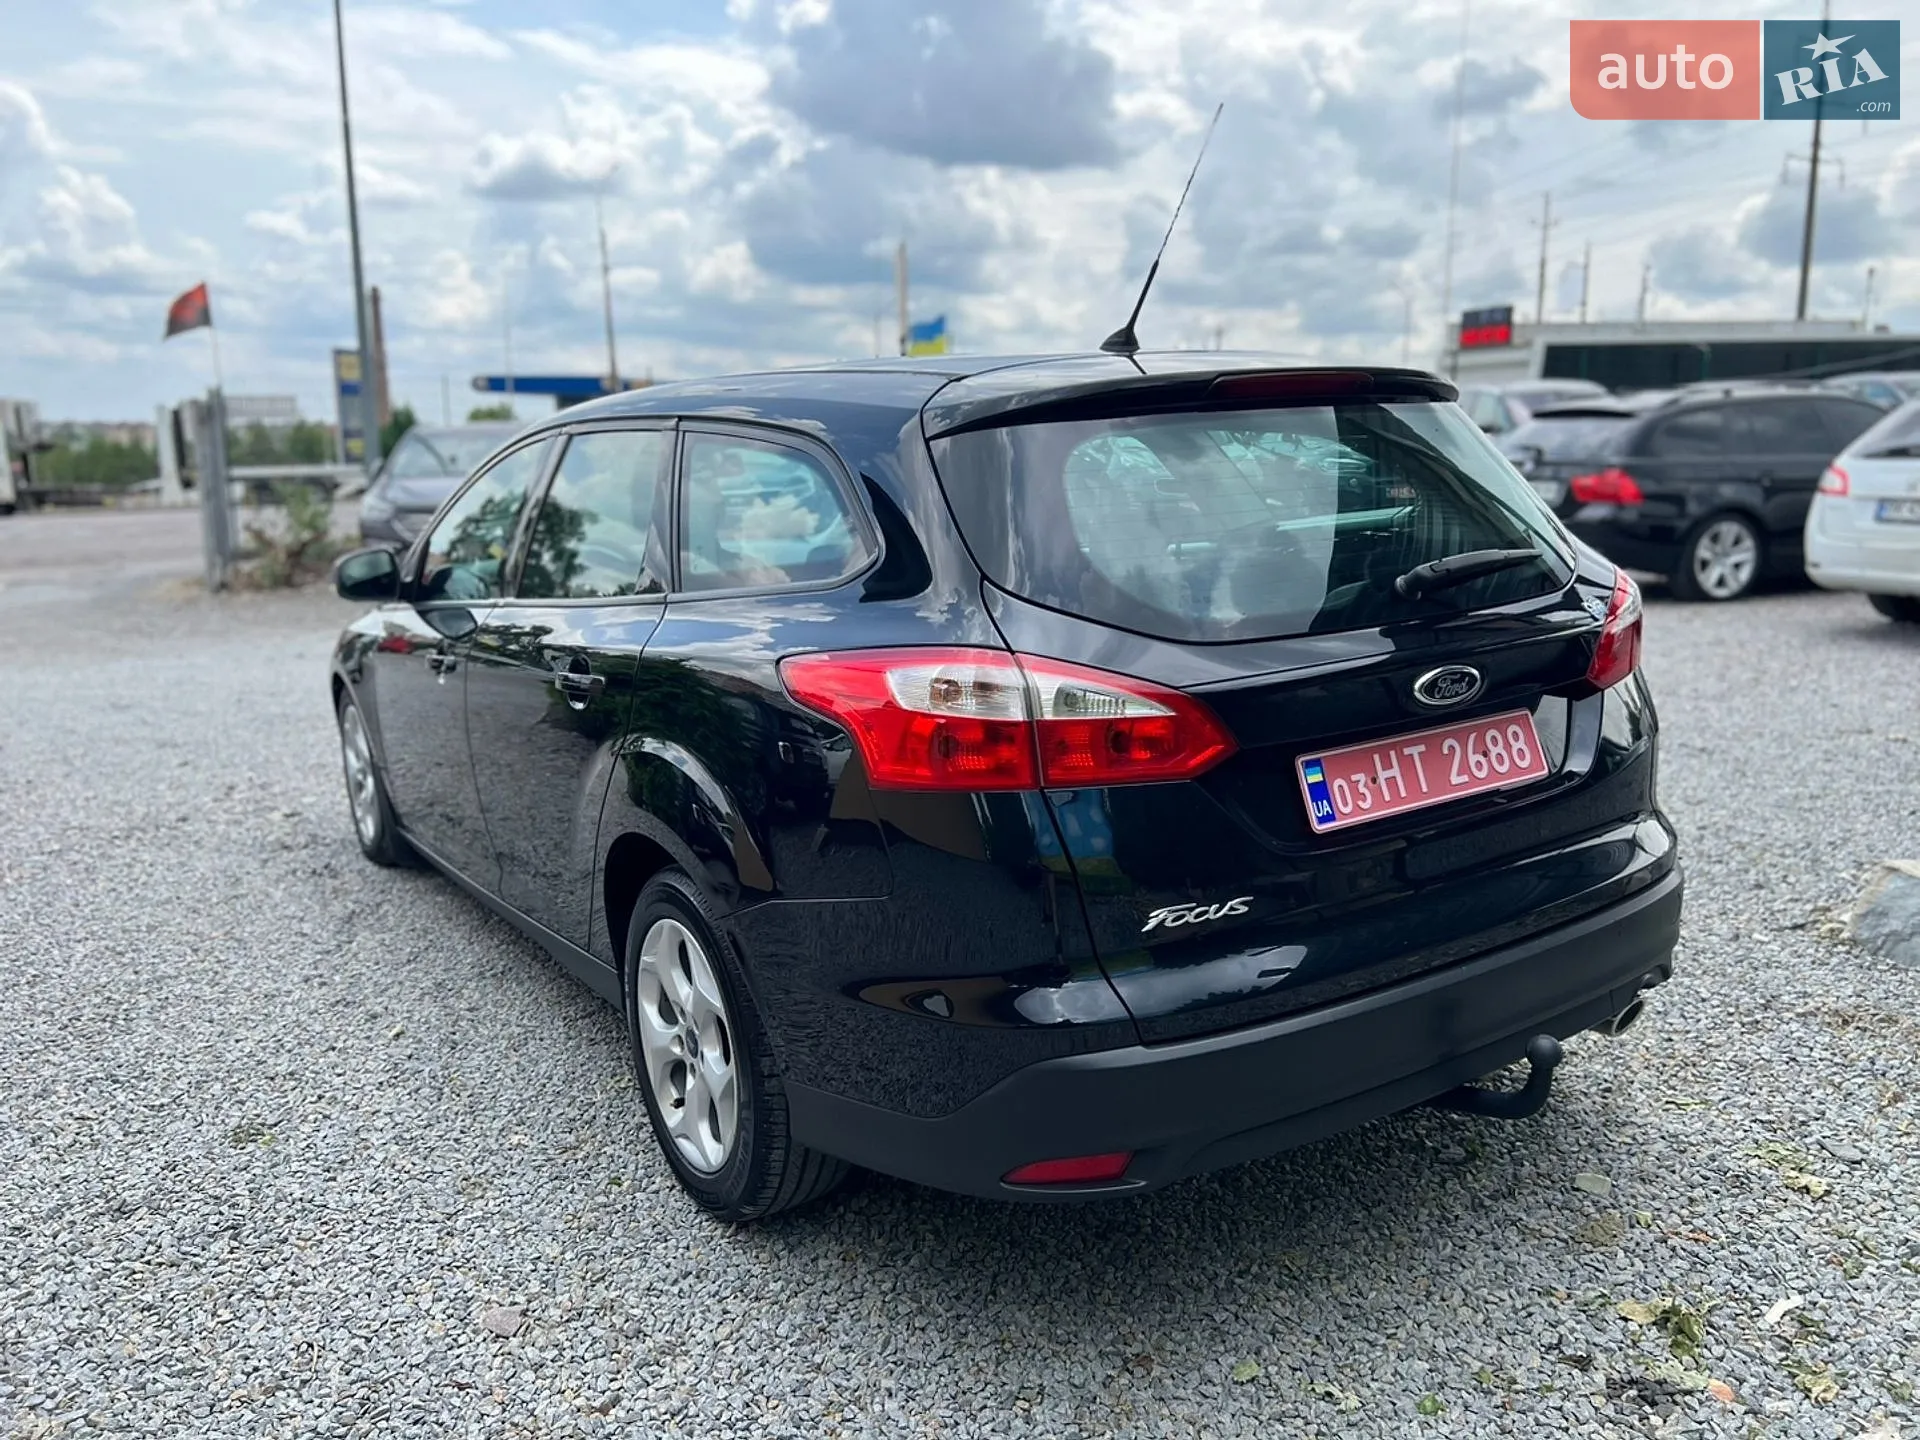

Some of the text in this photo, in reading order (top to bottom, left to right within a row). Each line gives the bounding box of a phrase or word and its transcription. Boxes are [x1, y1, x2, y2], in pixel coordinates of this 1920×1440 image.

[1434, 674, 1469, 698] Ford
[1442, 724, 1531, 786] 2688
[1314, 801, 1332, 818] UA
